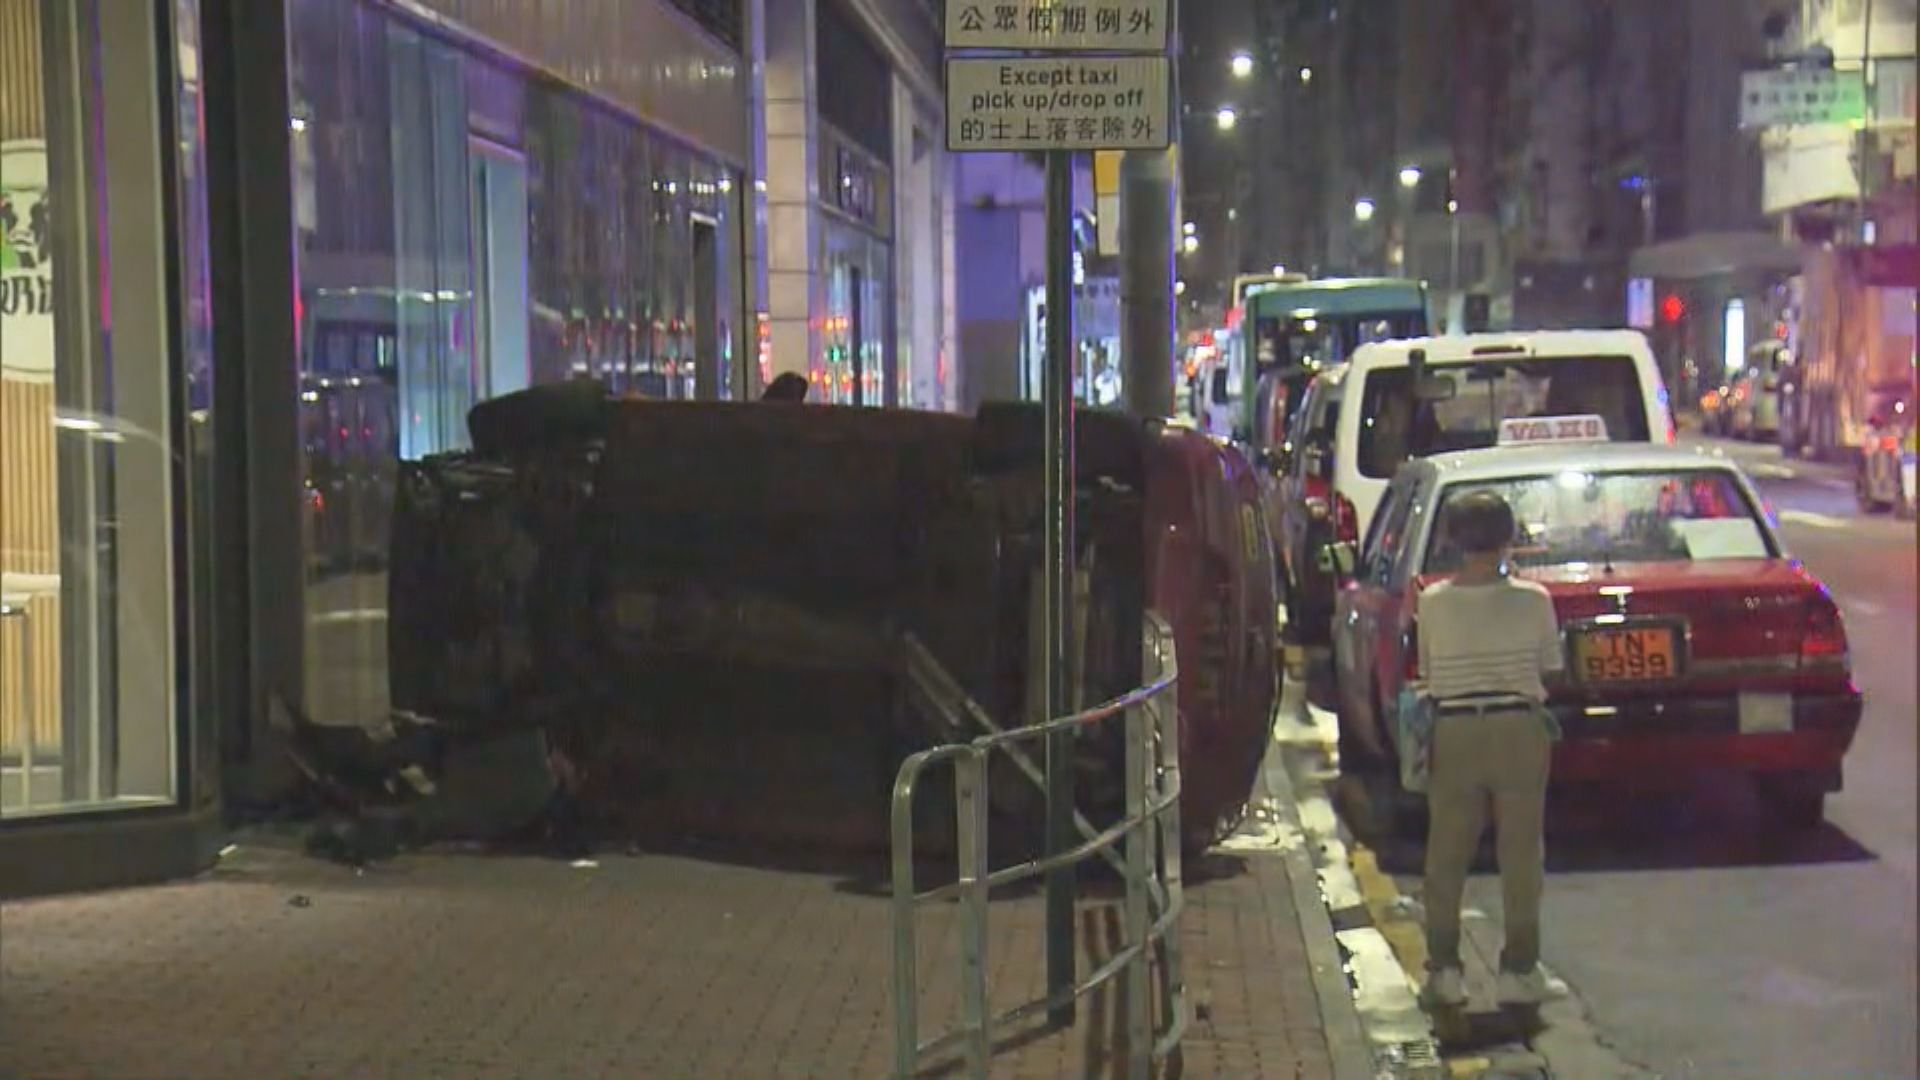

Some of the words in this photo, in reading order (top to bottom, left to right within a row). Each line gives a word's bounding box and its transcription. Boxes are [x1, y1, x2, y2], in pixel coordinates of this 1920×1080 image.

[959, 5, 1154, 35] 公眾假期例外
[1000, 66, 1073, 89] Except
[1079, 65, 1118, 86] taxi
[972, 90, 1015, 112] pick
[1023, 90, 1106, 111] up/drop
[1114, 88, 1144, 107] off
[960, 116, 1155, 142] 的士上落客除外
[1605, 630, 1644, 656] TN
